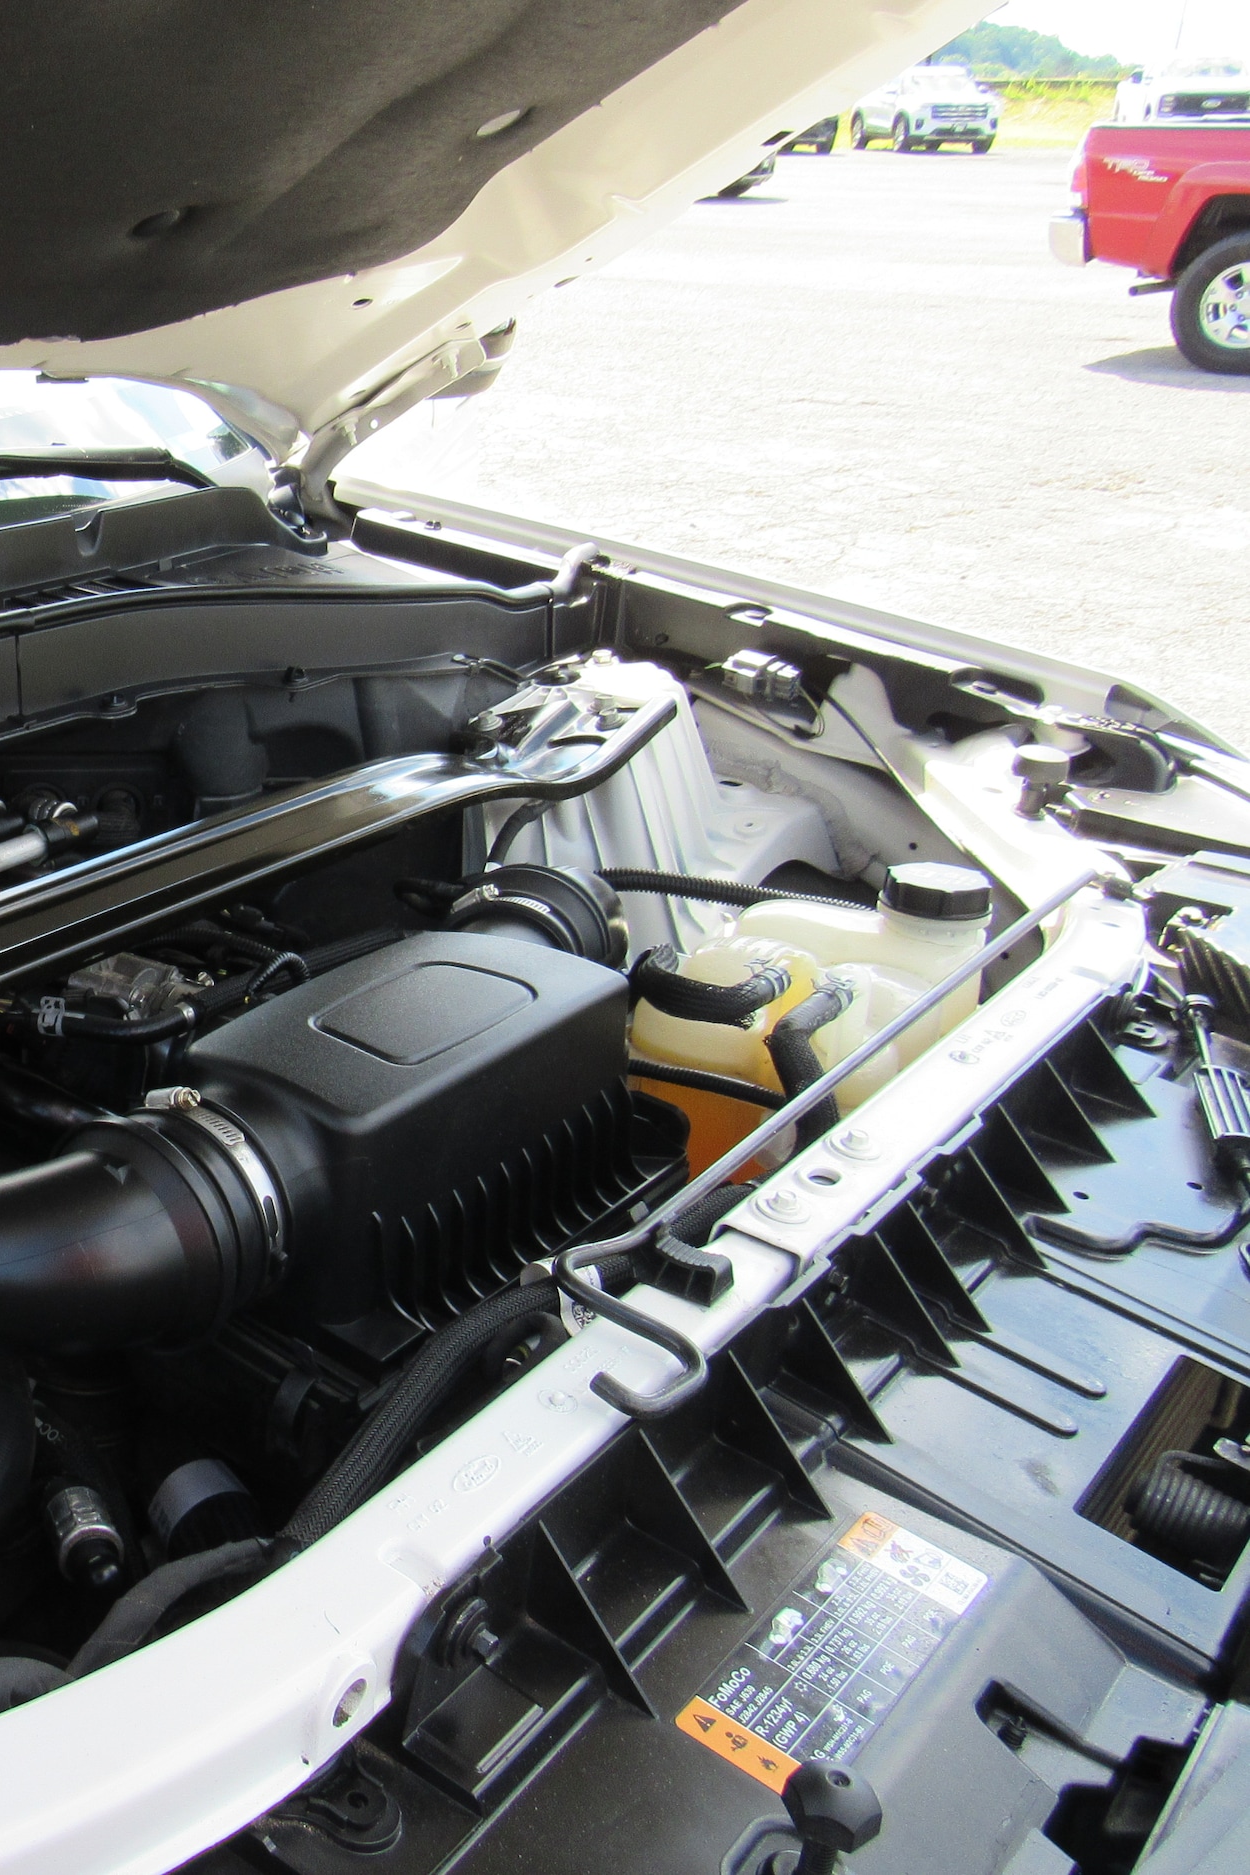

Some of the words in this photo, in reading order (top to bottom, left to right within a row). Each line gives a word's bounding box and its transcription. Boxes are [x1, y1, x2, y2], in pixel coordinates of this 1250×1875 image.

[1103, 157, 1149, 174] TRD
[818, 1617, 836, 1633] FHEV
[824, 1633, 846, 1654] 0.737
[838, 1626, 854, 1638] kg
[857, 1642, 871, 1653] lbs
[900, 1634, 915, 1648] PAG
[841, 1645, 852, 1654] 26
[801, 1659, 824, 1680] 0.680
[816, 1653, 832, 1664] kg
[878, 1661, 894, 1675] POE
[819, 1672, 830, 1681] 24
[834, 1669, 848, 1681] lbs
[705, 1664, 752, 1708] FoMoCo
[724, 1699, 743, 1716] SAE
[736, 1684, 758, 1702] J639
[855, 1688, 873, 1704] PAG
[736, 1702, 759, 1724] J2842
[752, 1685, 774, 1706] J2845
[754, 1696, 797, 1739] R-1234yf
[773, 1720, 805, 1750] (GWP
[792, 1711, 812, 1726] 4)
